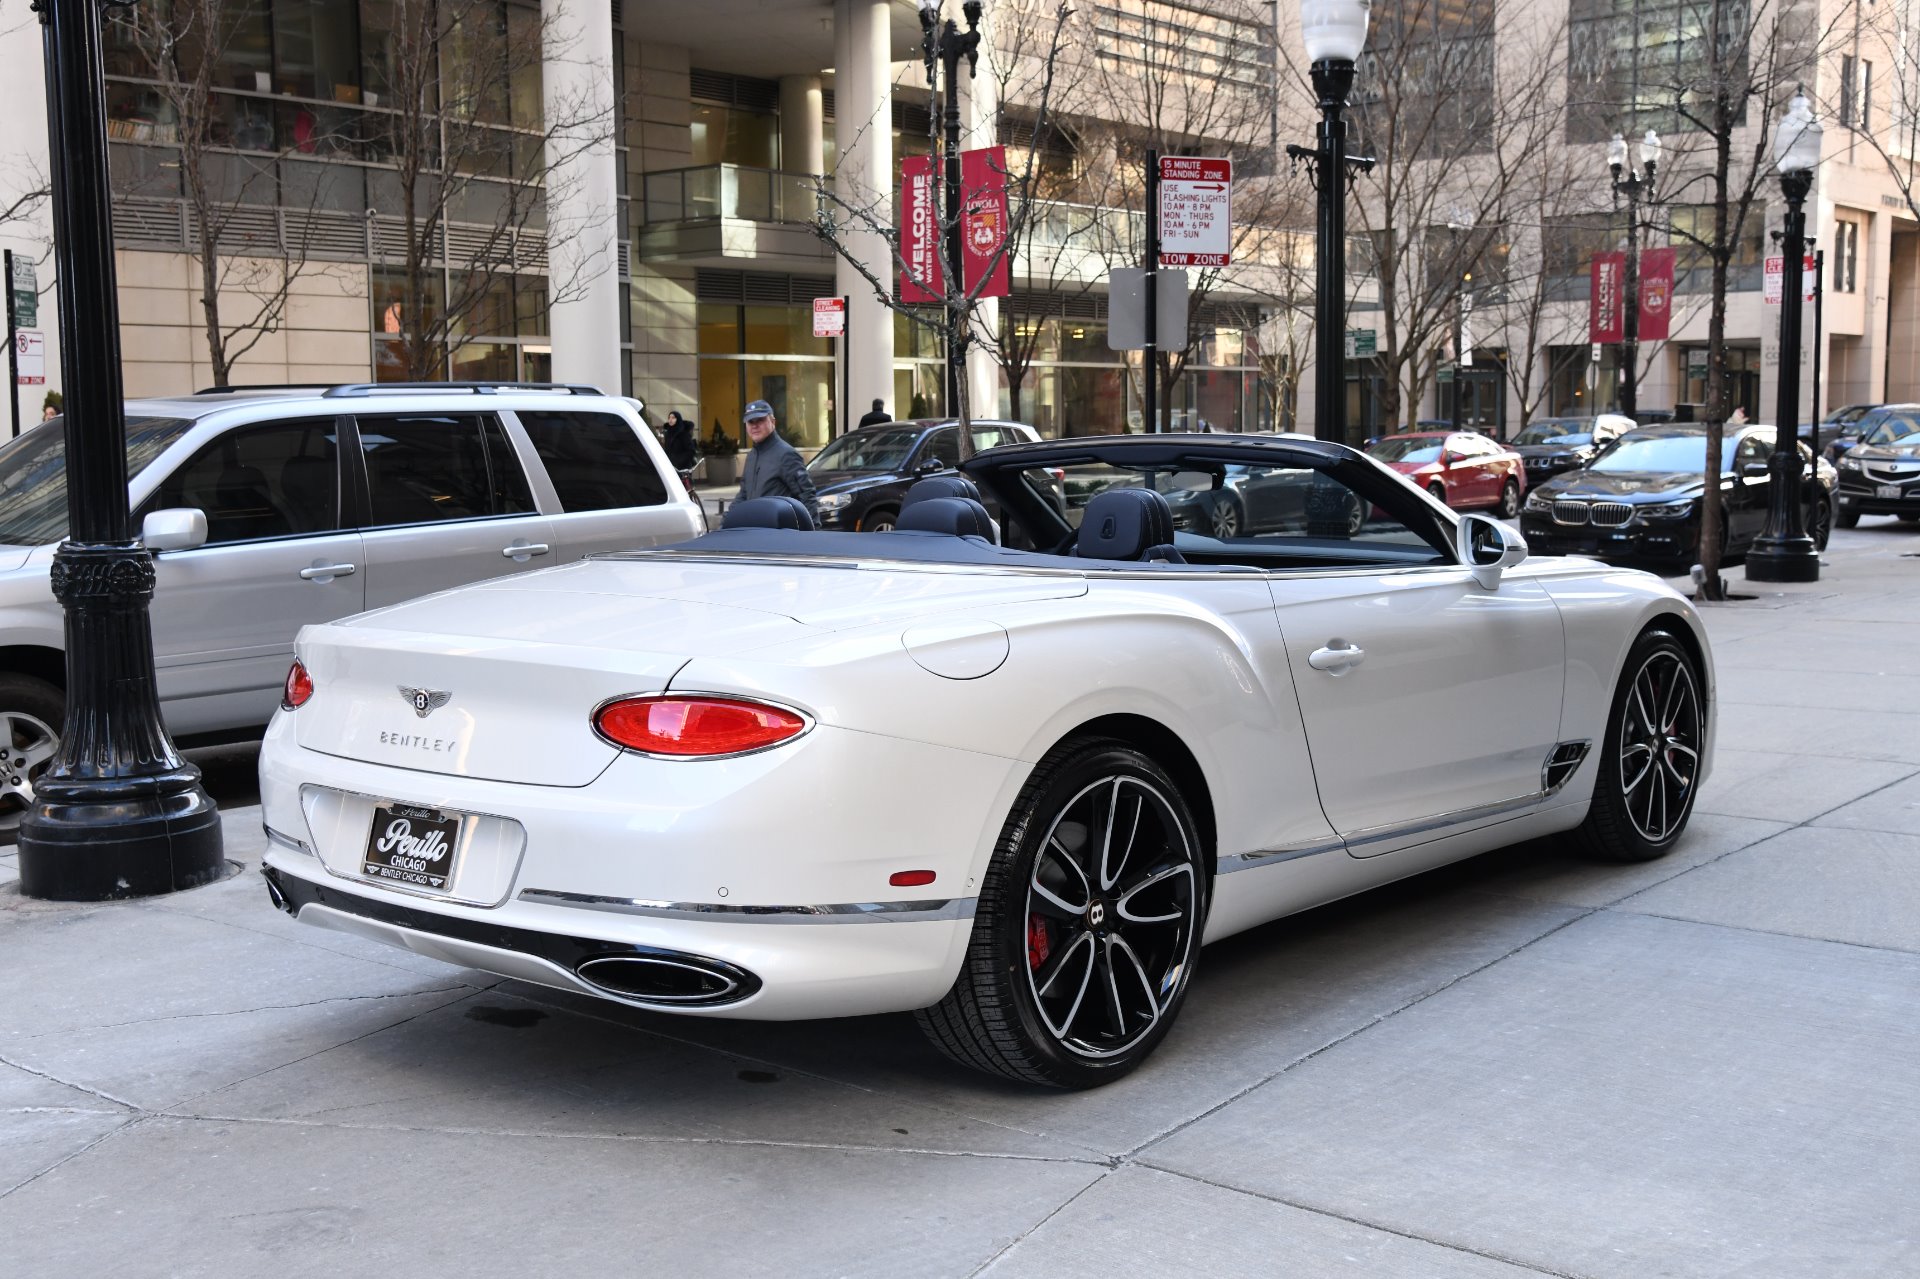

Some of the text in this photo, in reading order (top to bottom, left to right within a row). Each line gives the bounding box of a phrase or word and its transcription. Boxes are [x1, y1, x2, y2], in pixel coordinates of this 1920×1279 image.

[1164, 161, 1201, 169] 15 MINUTE
[1164, 170, 1223, 179] STANDING ZONE
[966, 199, 1000, 210] LOYOLA
[1164, 194, 1227, 203] FLASHING LIGHTS
[1189, 212, 1214, 220] THURS
[913, 175, 925, 281] WELCOME
[1164, 254, 1224, 265] TOW ZONE
[380, 731, 456, 752] BENTLEY
[377, 818, 448, 862] Perillo
[390, 855, 426, 872] CHICAGO
[380, 867, 428, 885] BENTLEY CHICAGO
[1091, 903, 1104, 925] B
